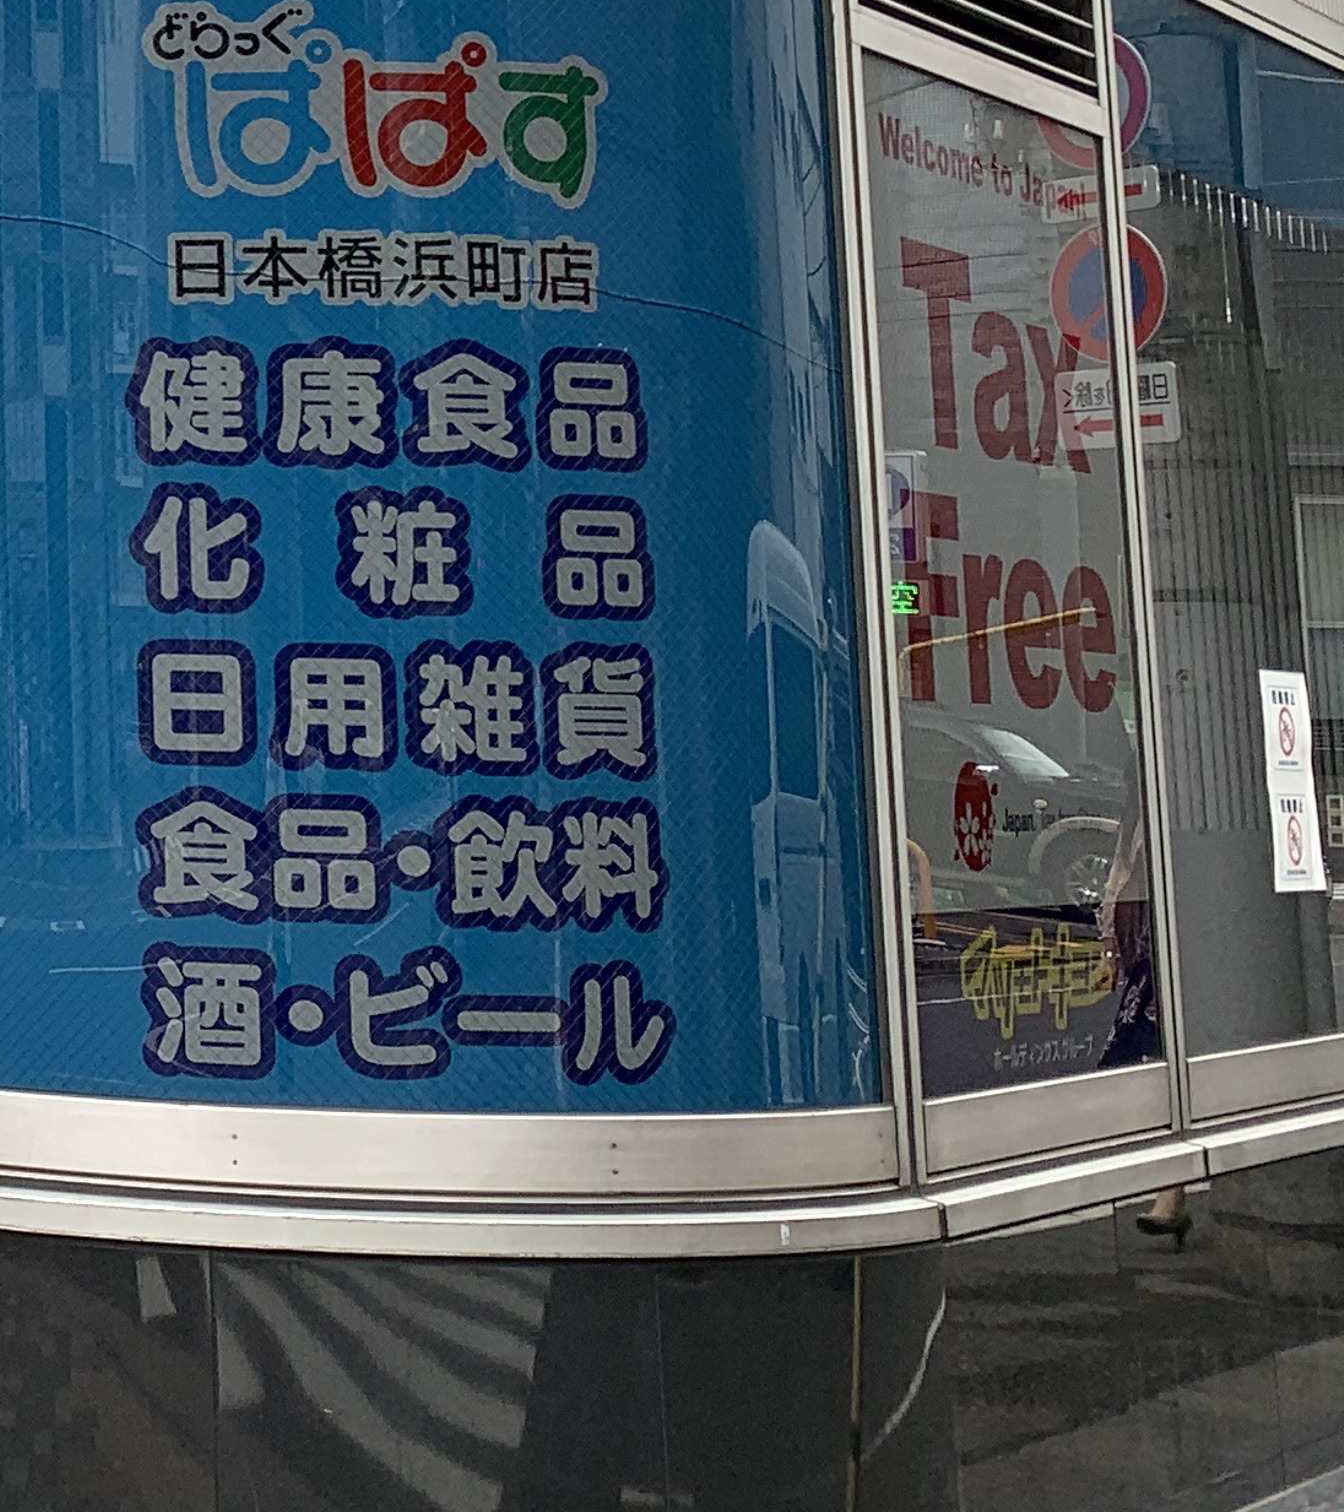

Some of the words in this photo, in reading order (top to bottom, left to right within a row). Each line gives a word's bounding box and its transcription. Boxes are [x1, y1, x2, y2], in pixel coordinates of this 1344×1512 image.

[152, 7, 304, 60] どらっぐ
[183, 38, 599, 200] ぱぱす
[877, 111, 984, 187] Welcome
[991, 159, 1014, 198] to
[1019, 160, 1086, 223] Japan!
[172, 235, 594, 305] 日本橋浜町店
[128, 338, 646, 471] 健康食品
[899, 236, 1093, 474] Tax
[132, 485, 655, 620] 化粧品
[904, 488, 1118, 713] Free
[138, 639, 660, 779] 日用雑貨
[138, 786, 668, 932] 食品・飲料
[141, 941, 675, 1085] 酒・ビール
